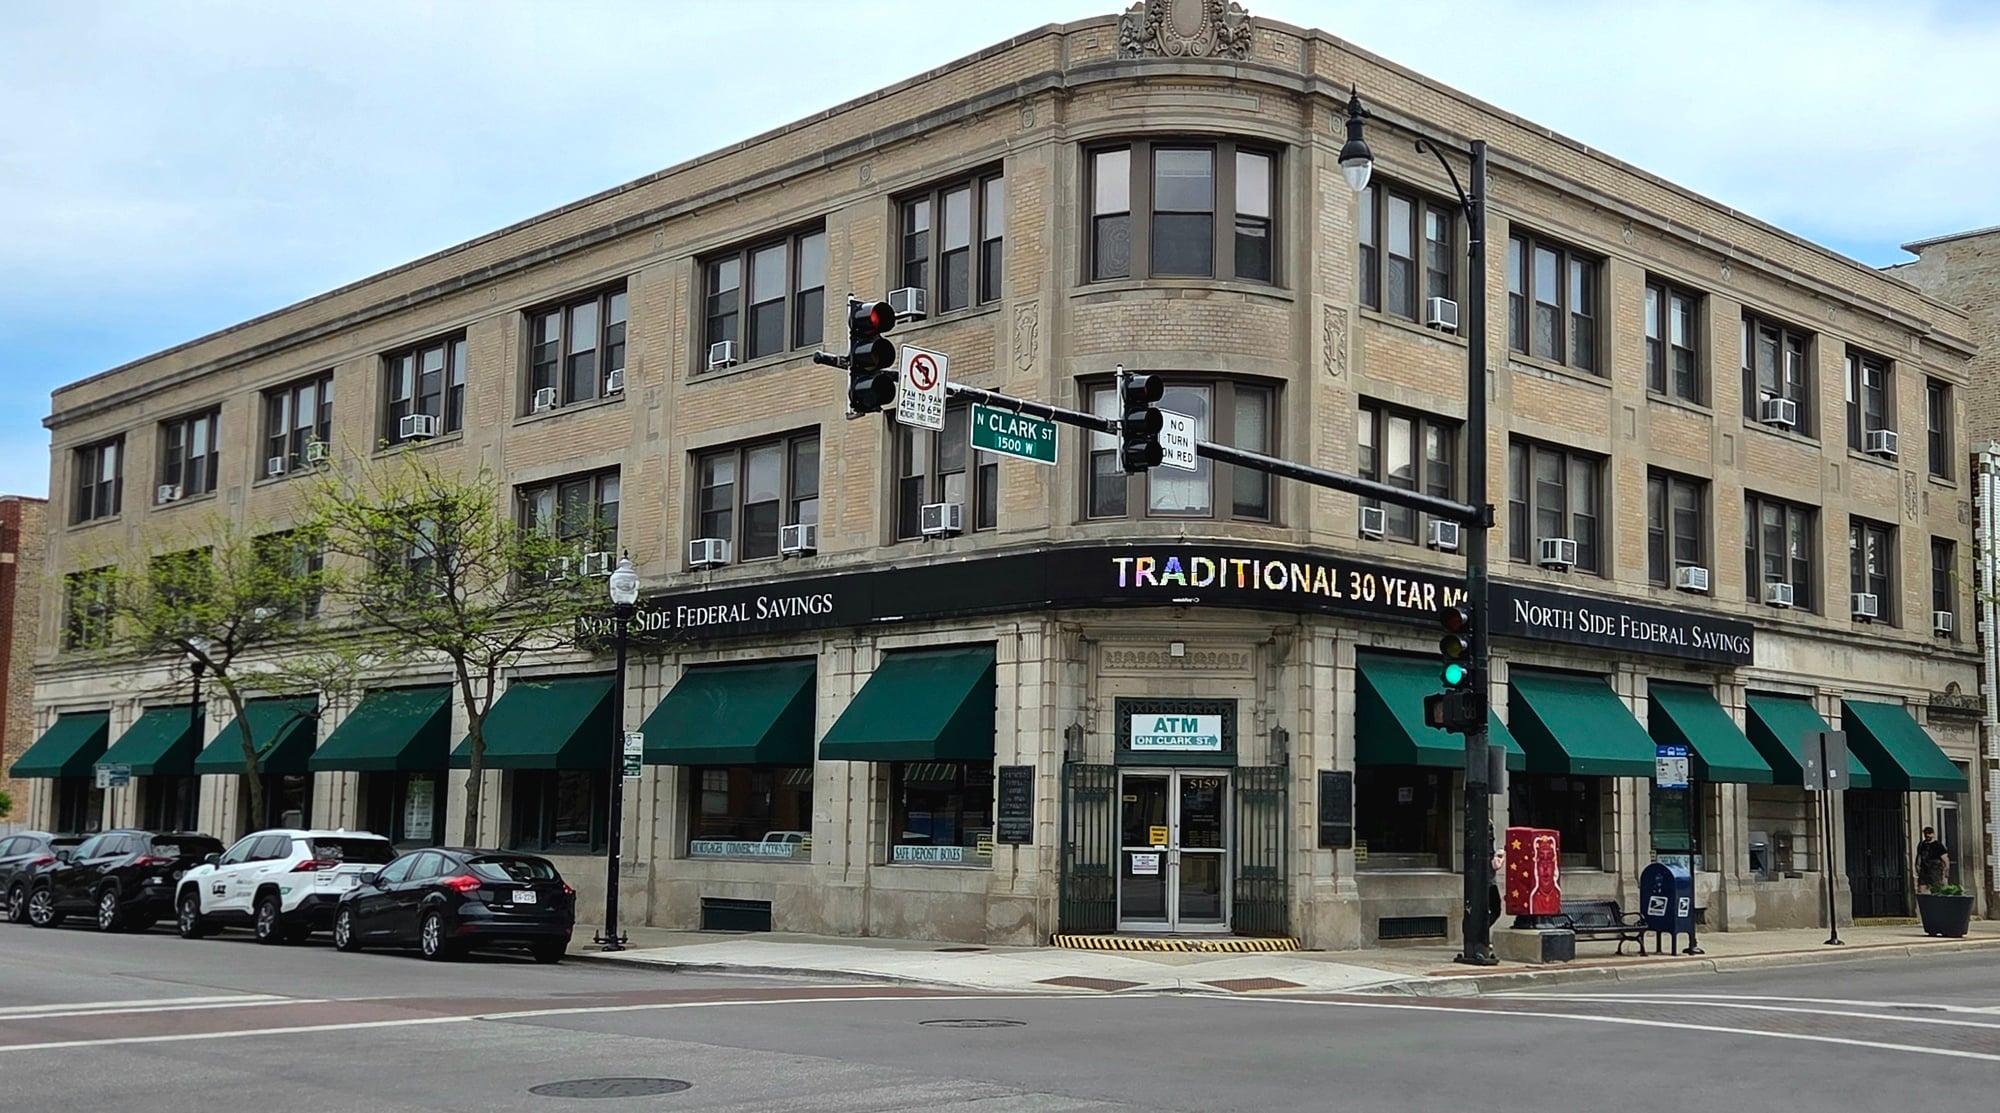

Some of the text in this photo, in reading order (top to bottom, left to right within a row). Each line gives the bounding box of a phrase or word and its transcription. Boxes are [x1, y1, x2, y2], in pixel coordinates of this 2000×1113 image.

[918, 392, 926, 401] TO
[918, 403, 926, 412] TO
[977, 413, 1053, 440] N CLARK ST
[1170, 419, 1184, 431] NO
[998, 436, 1033, 455] 1500 W
[1167, 433, 1188, 447] TURN
[1162, 447, 1193, 463] ON RED
[1112, 556, 1468, 612] TRADITIONAL 30 YEAR M
[635, 610, 671, 632] SIDE
[676, 603, 750, 630] FEDERAL
[756, 593, 833, 620] SAVINGS
[1514, 598, 1750, 655] NORTH SIDE FEDERAL SAVINGS
[1153, 717, 1198, 733] ATM
[1137, 736, 1152, 745] ON
[1157, 736, 1192, 745] CLARK
[1190, 779, 1218, 789] 5159
[895, 847, 960, 860] SAFE DEPOSIT BOXES
